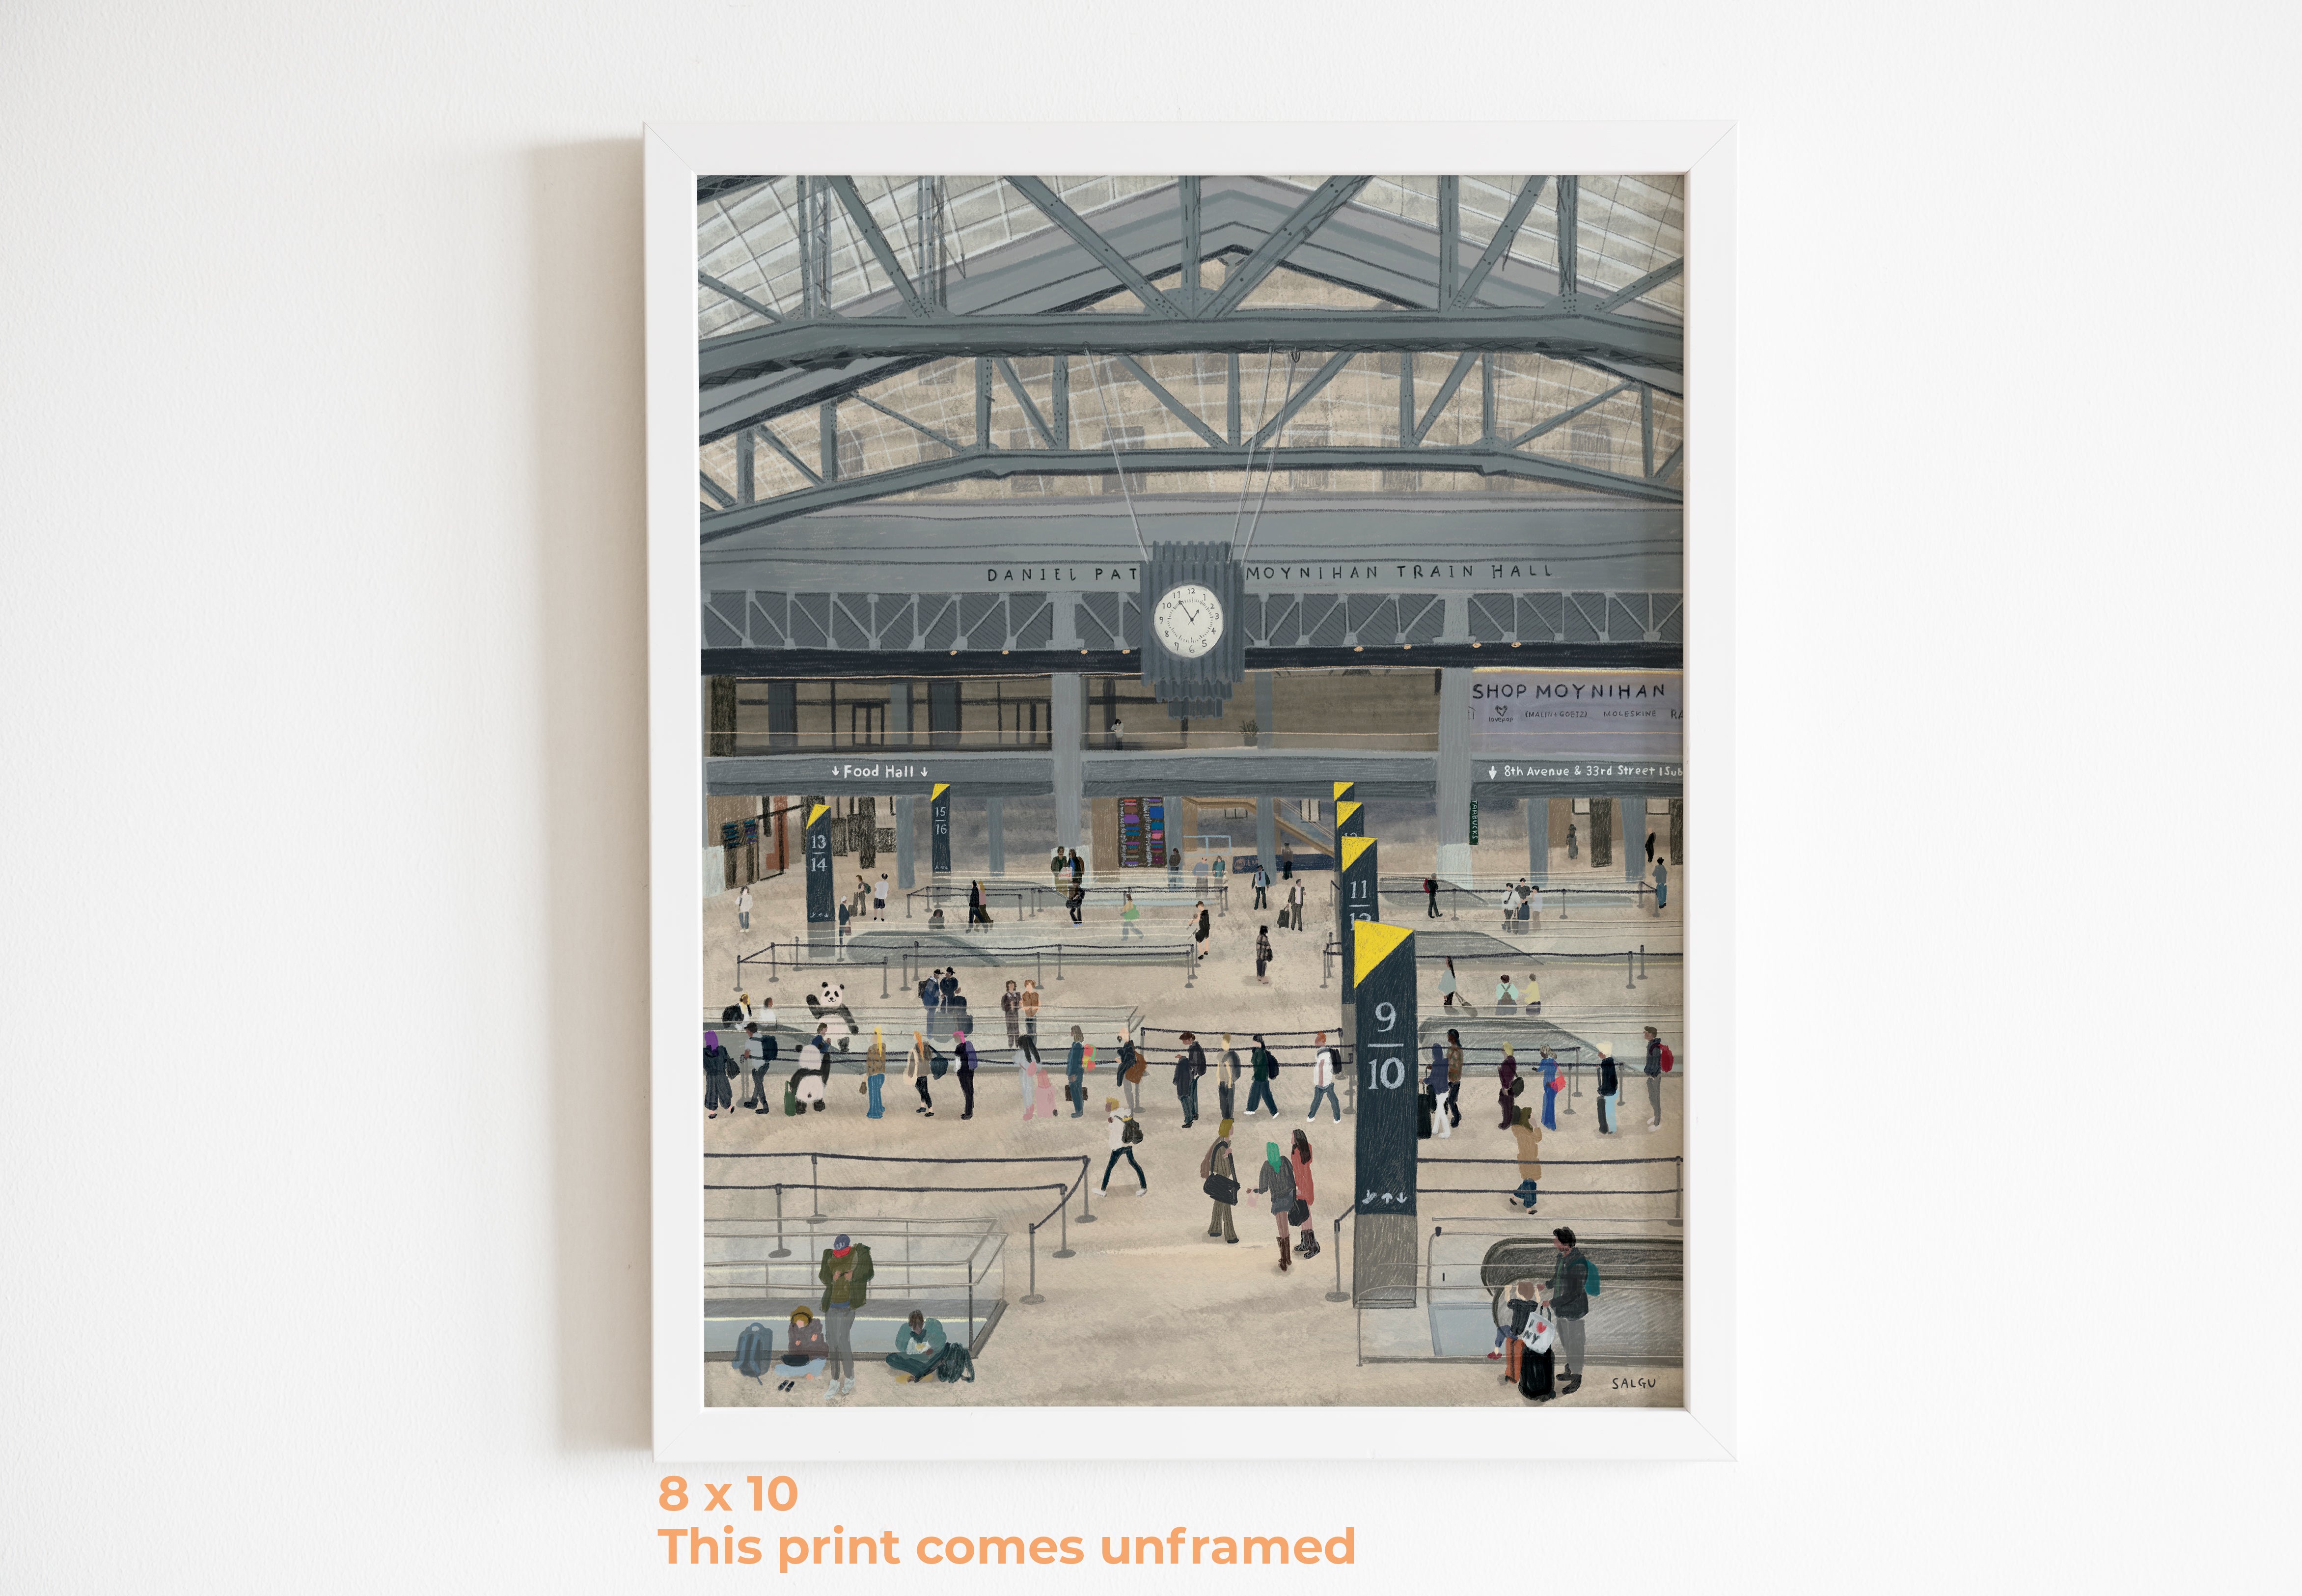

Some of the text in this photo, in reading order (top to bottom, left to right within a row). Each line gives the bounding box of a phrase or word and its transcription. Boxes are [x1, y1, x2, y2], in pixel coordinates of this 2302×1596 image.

[987, 564, 1552, 581] DANIEL PAT MOYNIHAN TRAIN HALL
[1174, 642, 1179, 651] 7
[1189, 645, 1195, 653] 6
[1202, 639, 1207, 647] 5
[1473, 683, 1665, 699] SHOP MOYNIHAN
[844, 764, 914, 779] Food Hall
[1504, 765, 1524, 777] 8th
[1527, 767, 1569, 776] Avenue
[1574, 765, 1582, 775] &
[1586, 765, 1612, 776] 33rd
[1617, 765, 1656, 775] Street
[935, 807, 946, 817] 15
[936, 824, 947, 834] 16
[810, 835, 826, 849] 13
[810, 857, 828, 872] 14
[1350, 880, 1367, 899] 11
[1374, 1002, 1397, 1032] 9
[1368, 1056, 1405, 1090] 10
[1528, 1319, 1535, 1328] I
[1523, 1330, 1540, 1345] NY
[1612, 1377, 1656, 1390] SALGU
